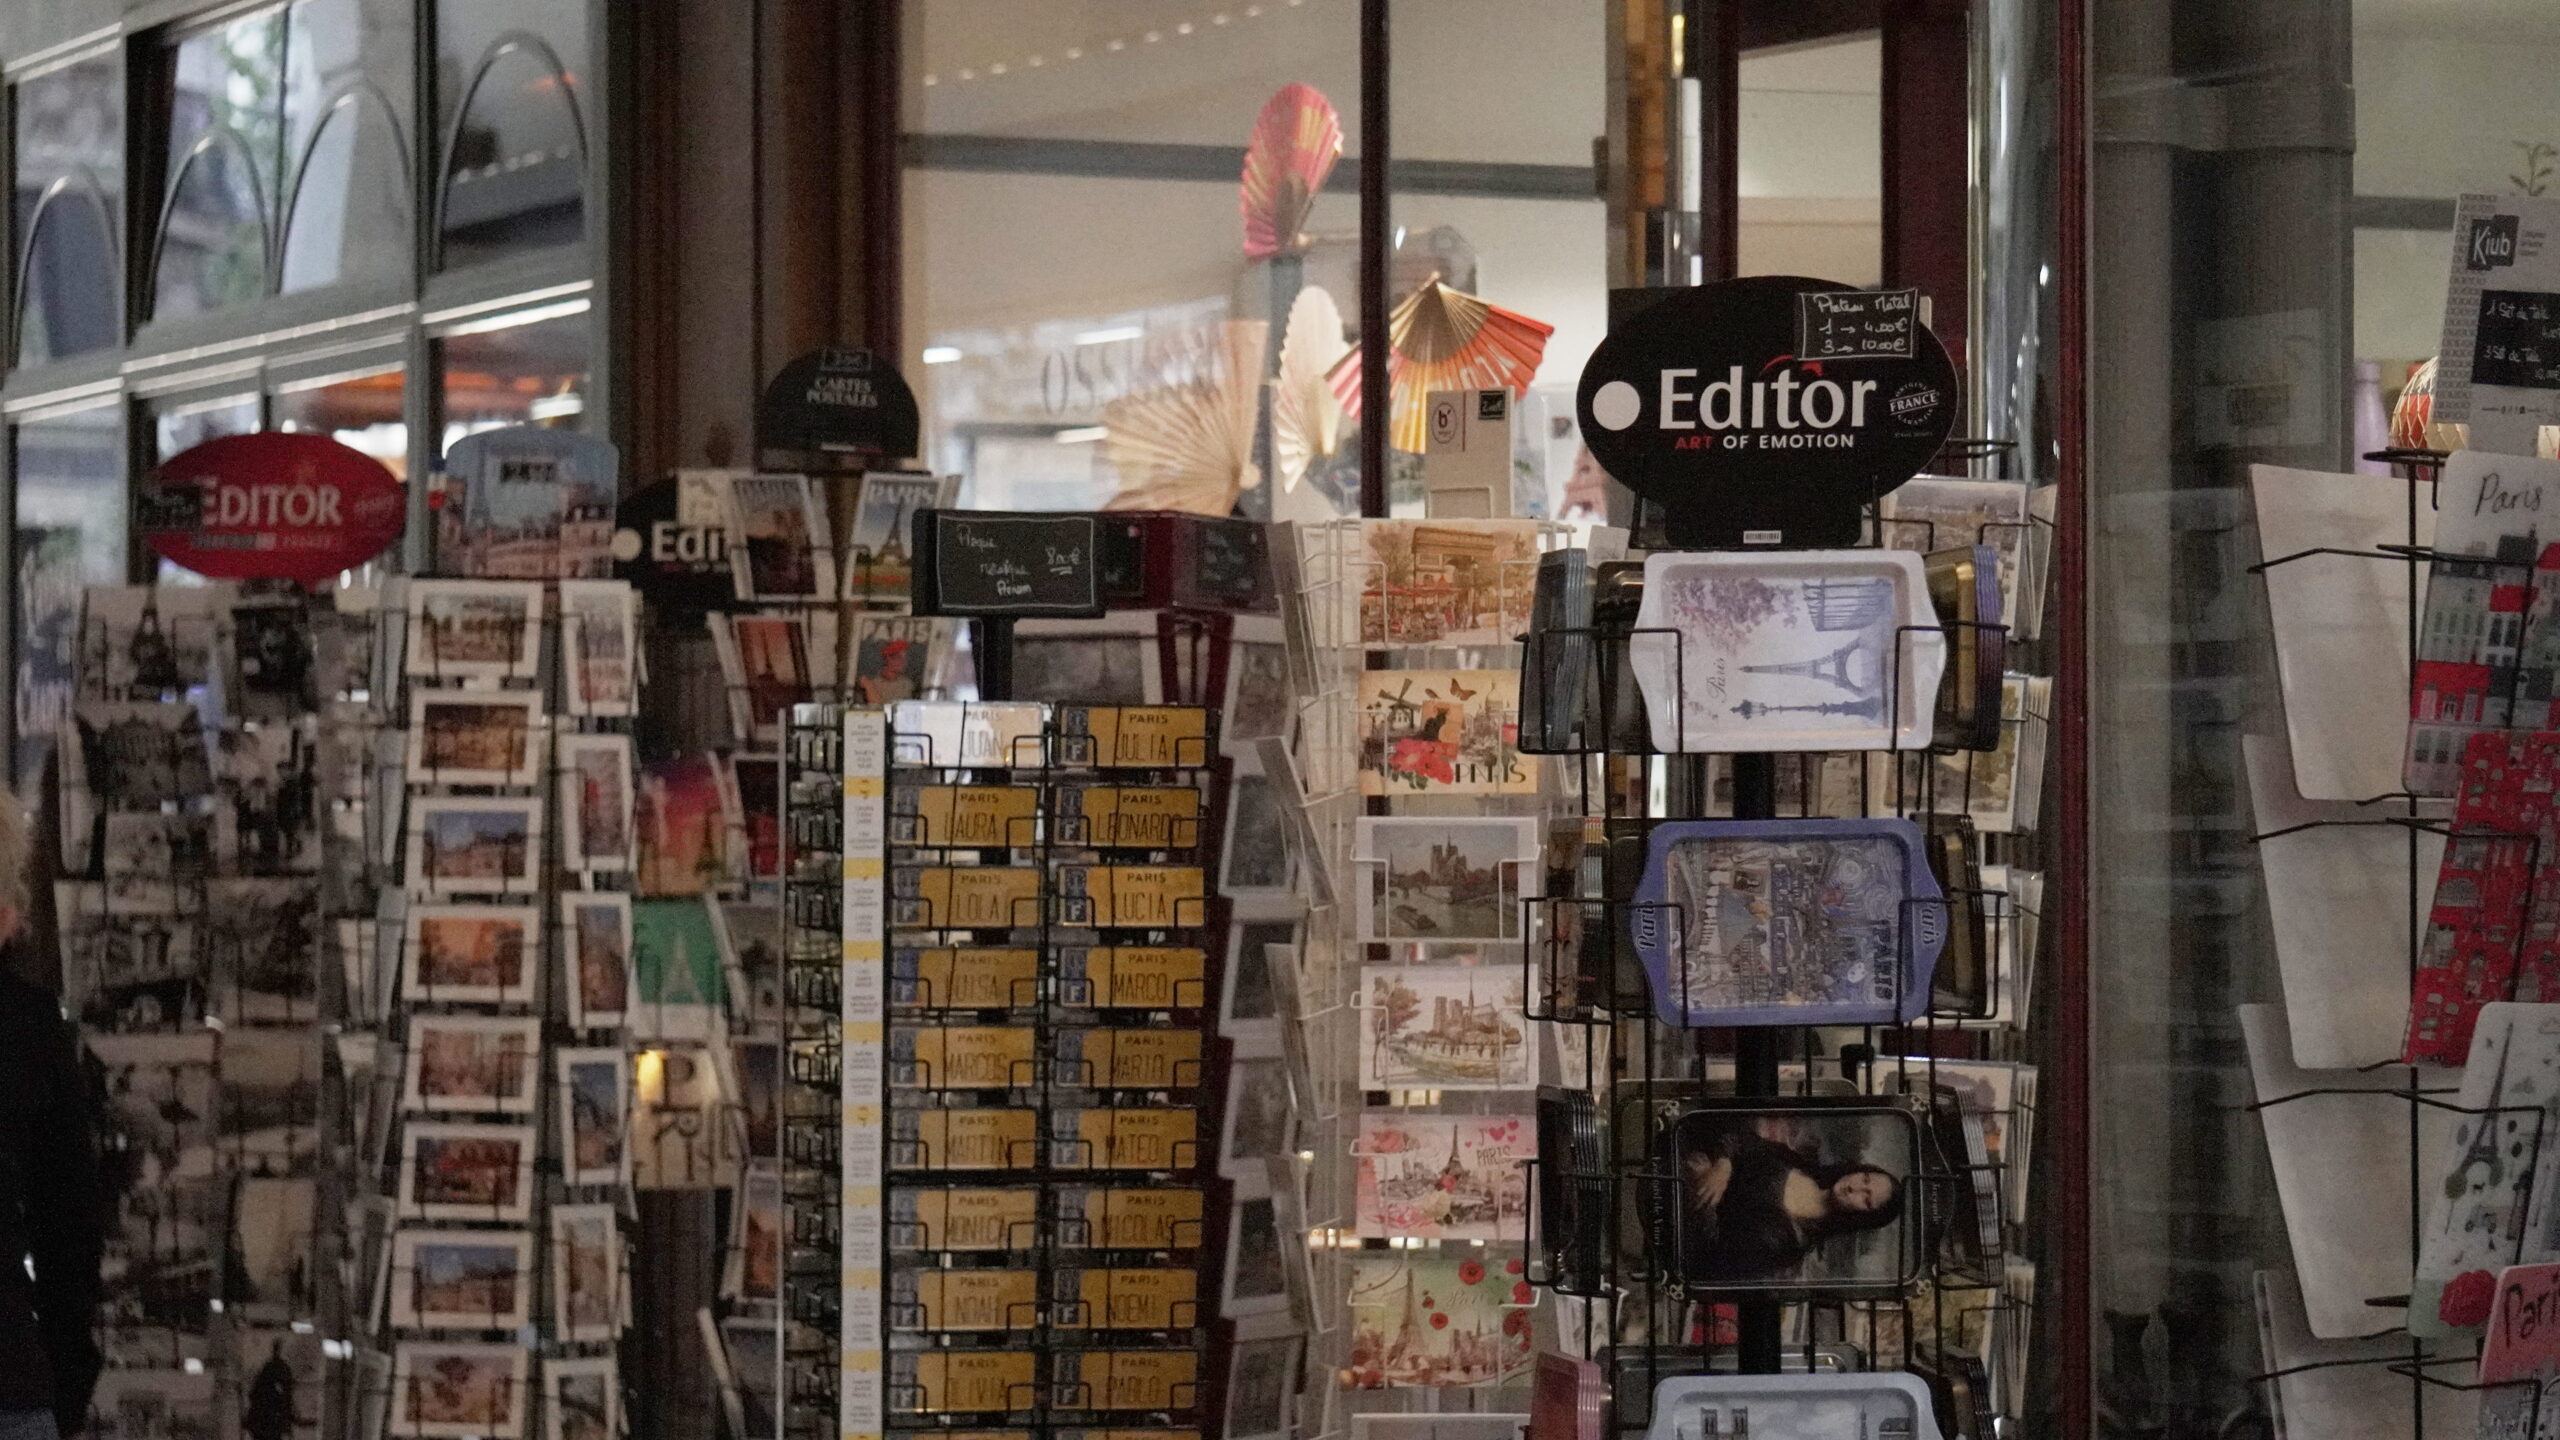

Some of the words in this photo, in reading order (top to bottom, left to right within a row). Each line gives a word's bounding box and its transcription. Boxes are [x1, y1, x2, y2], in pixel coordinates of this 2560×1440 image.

[2473, 226, 2511, 265] Kiub
[1821, 339, 1835, 353] 3
[1660, 365, 1876, 430] Editor
[1890, 393, 1937, 412] FRANCE
[1676, 437, 1713, 449] ART
[1723, 435, 1749, 449] OF
[1759, 434, 1854, 448] EMOTION
[2475, 473, 2543, 516] Paris
[863, 616, 930, 642] PARIS
[1129, 714, 1168, 723] PARIS
[1072, 744, 1082, 761] F
[1115, 733, 1167, 761] JULIA
[960, 792, 999, 804] PARIS
[1122, 794, 1161, 804] PARIS
[943, 811, 997, 841] LAURA
[1064, 824, 1075, 840] F
[1097, 813, 1182, 842] LEONARDO
[960, 874, 1001, 884] PARIS
[1127, 873, 1167, 883] PARIS
[955, 894, 1000, 922] LOLA
[1070, 904, 1081, 921] F
[1111, 893, 1167, 922] LUCIA
[960, 956, 1000, 966] PARIS
[1128, 954, 1167, 964] PARIS
[1071, 985, 1082, 1002] F
[1113, 973, 1168, 1001] MARCO
[957, 1033, 997, 1045] PARIS
[1125, 1036, 1164, 1046] PARIS
[959, 1115, 998, 1127] PARIS
[1120, 1115, 1159, 1125] PARIS
[959, 1196, 999, 1206] PARIS
[1127, 1196, 1166, 1205] PARIS
[960, 1277, 999, 1287] PARIS
[1121, 1275, 1160, 1285] PARIS
[2504, 1273, 2560, 1349] Pari
[959, 1358, 999, 1368] PARIS
[1121, 1358, 1160, 1368] PARIS
